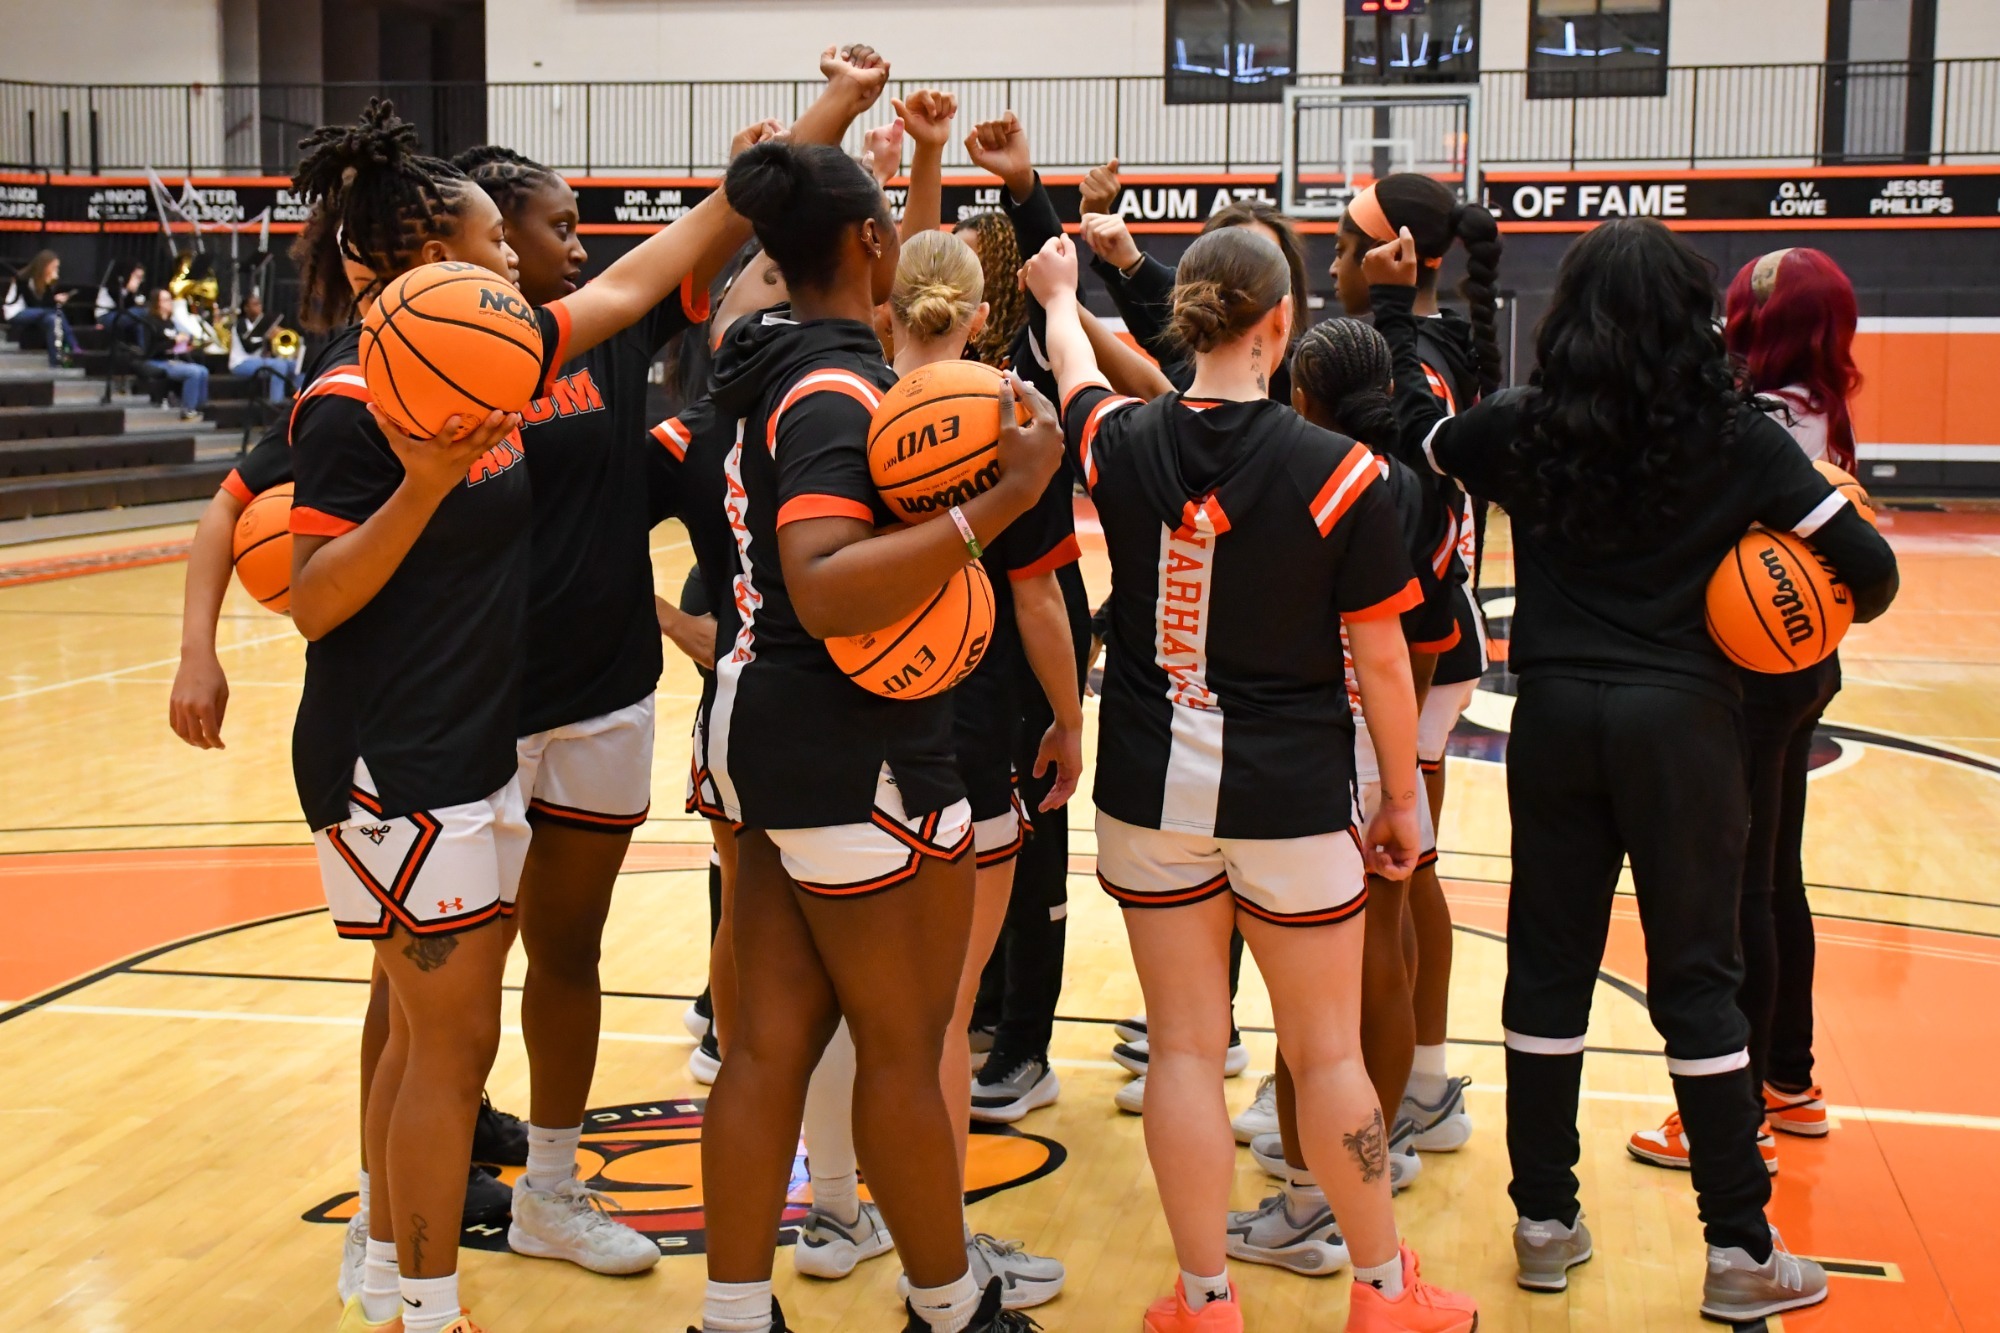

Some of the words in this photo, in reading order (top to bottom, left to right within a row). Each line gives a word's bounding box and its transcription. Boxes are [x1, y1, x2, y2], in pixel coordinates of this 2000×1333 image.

[624, 190, 651, 205] DR.
[655, 190, 682, 205] JIM
[1116, 188, 1198, 219] AUM
[1512, 185, 1566, 218] OF
[1578, 184, 1687, 217] FAME
[1881, 179, 1944, 197] JESSE
[1770, 199, 1827, 216] LOWE
[1869, 197, 1954, 215] PHILLIPS
[516, 367, 606, 431] UM
[897, 415, 960, 462] EVO
[1758, 546, 1815, 647] Wilson
[882, 644, 937, 693] EVO
